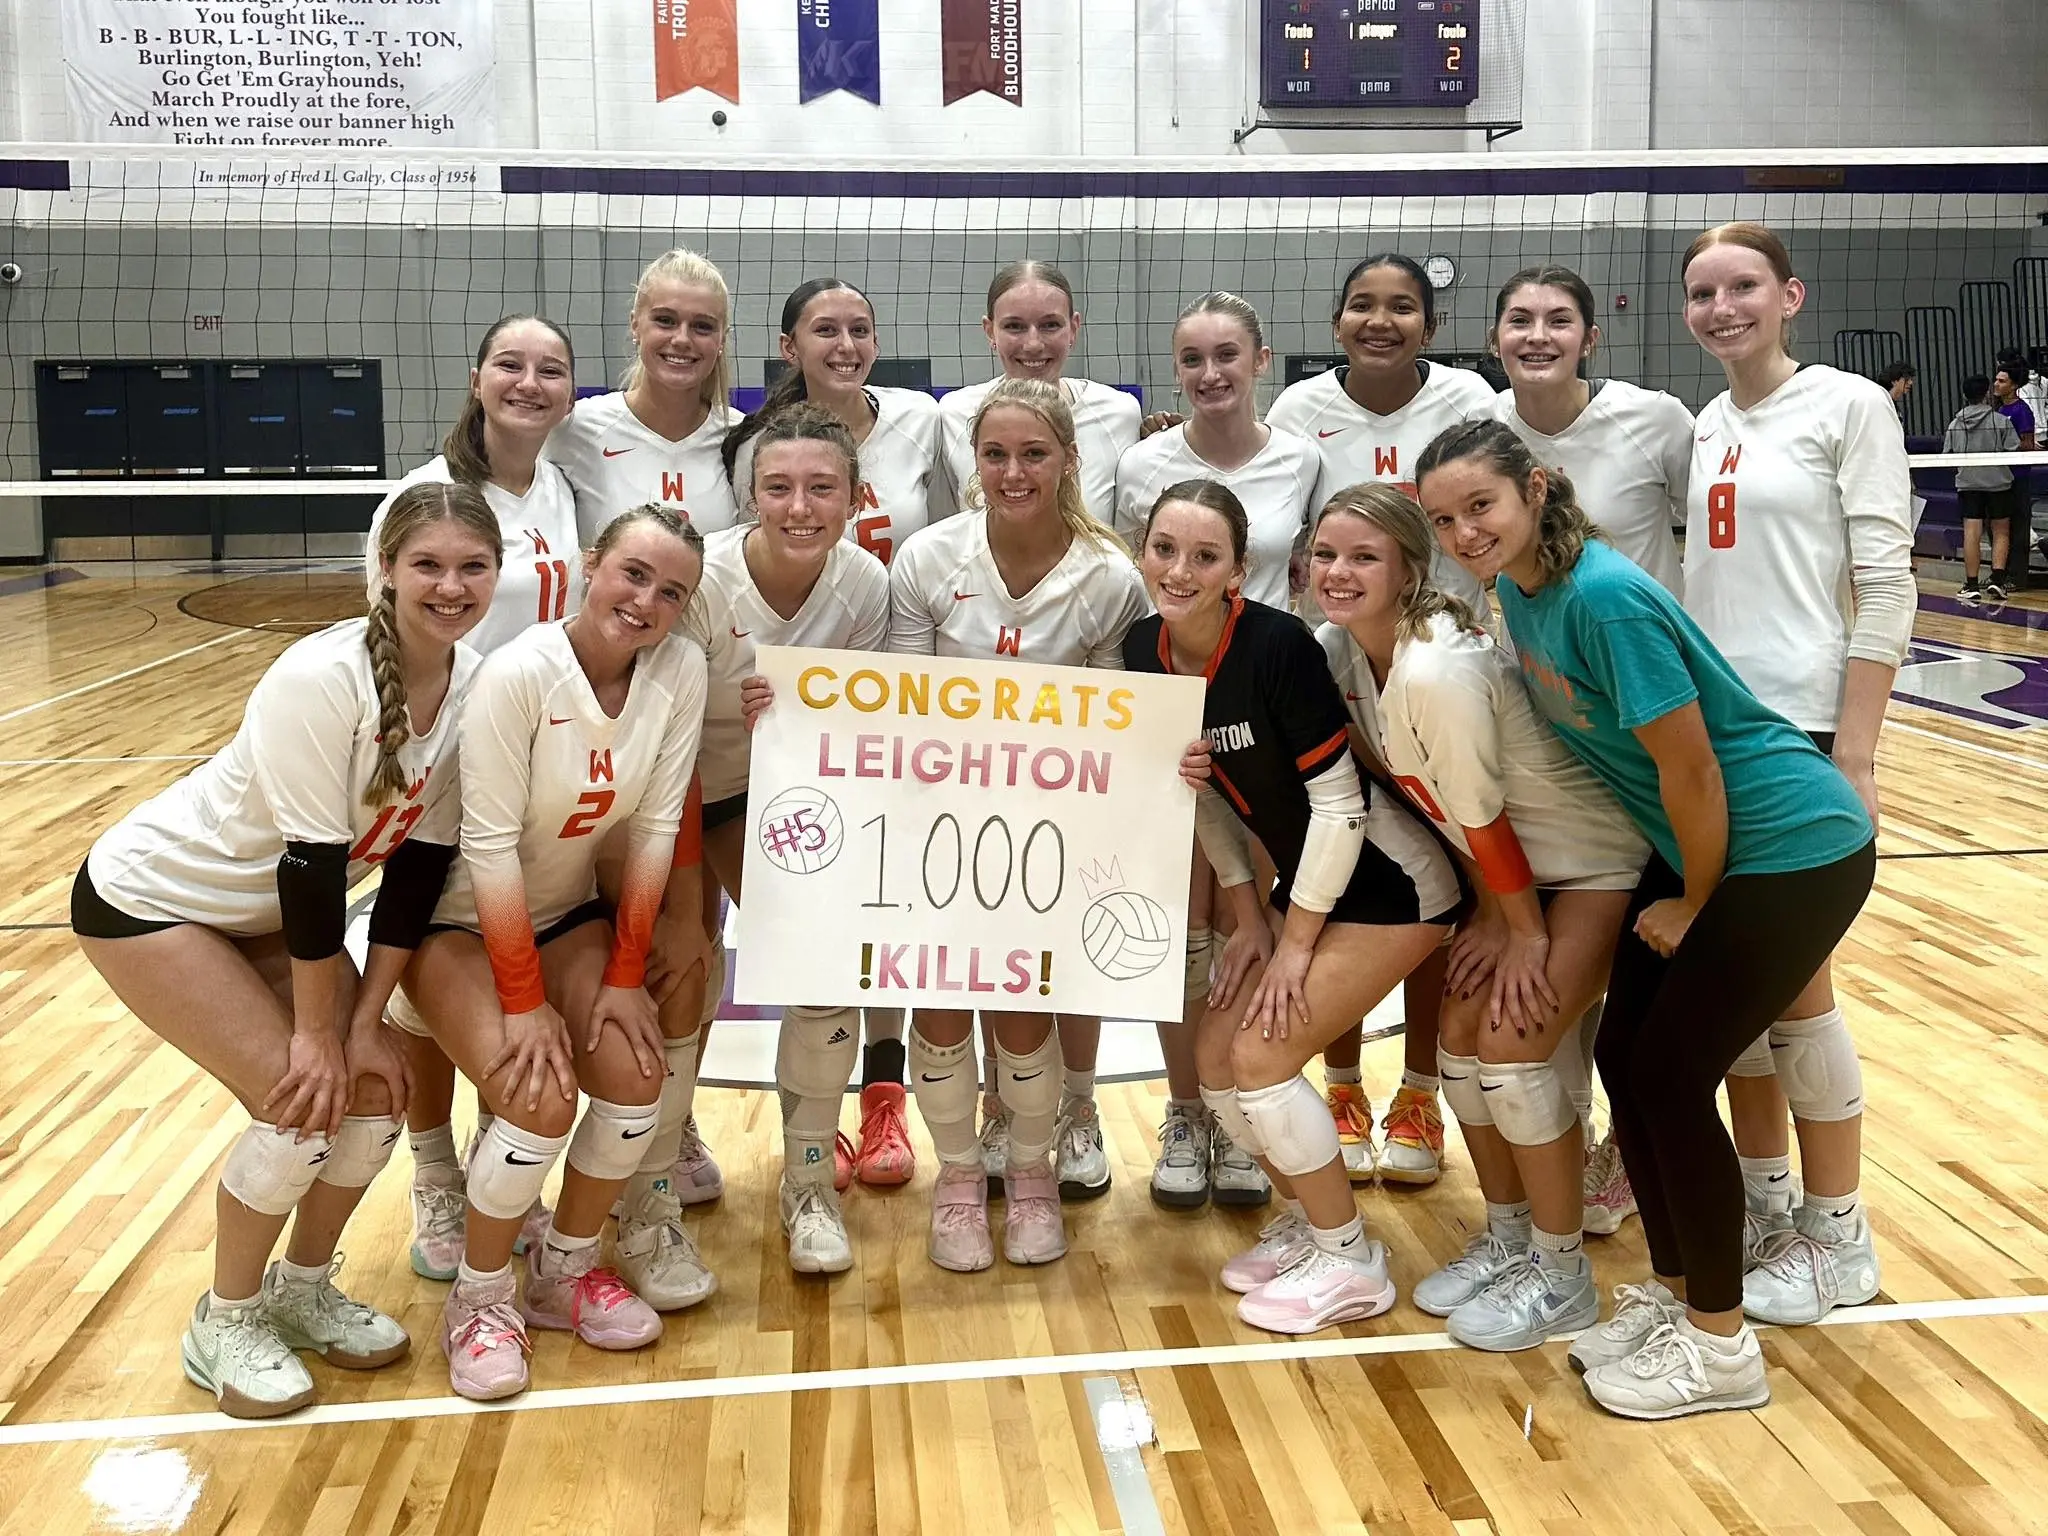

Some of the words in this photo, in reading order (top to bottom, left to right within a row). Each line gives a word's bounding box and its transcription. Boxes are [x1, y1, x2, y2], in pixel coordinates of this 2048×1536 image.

[195, 8, 235, 24] You
[243, 9, 305, 30] fought
[312, 9, 365, 26] like...
[1358, 0, 1396, 13] period
[99, 29, 113, 44] B
[135, 29, 148, 44] B
[169, 29, 222, 48] BUR,
[290, 31, 338, 48] ING,
[406, 32, 463, 50] TON,
[990, 28, 1000, 58] FORT
[139, 50, 252, 70] Burlington,
[258, 51, 371, 72] Burlington,
[377, 52, 421, 67] Yeh!
[1446, 46, 1461, 70] 2
[162, 71, 190, 86] Go
[197, 71, 230, 86] Get
[237, 71, 273, 86] 'Em
[278, 72, 405, 92] Grayhounds,
[1287, 80, 1310, 92] won
[1360, 81, 1390, 94] game
[1440, 80, 1463, 92] won
[152, 91, 214, 107] March
[222, 92, 300, 112] Proudly
[306, 95, 324, 108] at
[330, 92, 360, 108] the
[366, 92, 410, 111] fore,
[108, 111, 150, 127] And
[156, 111, 209, 128] when
[215, 117, 241, 128] we
[248, 112, 293, 128] raise
[299, 117, 333, 129] our
[339, 113, 407, 129] banner
[412, 114, 454, 134] high
[231, 137, 254, 145] on
[262, 132, 331, 146] forever
[199, 170, 213, 182] In
[219, 172, 270, 185] memory
[274, 170, 288, 186] of
[290, 170, 320, 182] Fred
[390, 170, 425, 183] Class
[194, 315, 221, 330] EXIT
[1374, 446, 1397, 475] W
[1719, 444, 1742, 475] W
[662, 472, 683, 501] W
[1708, 483, 1736, 549] 8
[535, 560, 568, 622] 11
[996, 625, 1021, 657] W
[797, 666, 1136, 731] CONGRATS
[590, 748, 613, 783] W
[818, 732, 1113, 794] LEIGHTON
[557, 790, 616, 838] 2
[348, 804, 424, 864] 13
[764, 808, 827, 858] #5
[860, 812, 1065, 914] 1,000
[859, 942, 1052, 996] !KILLS!
